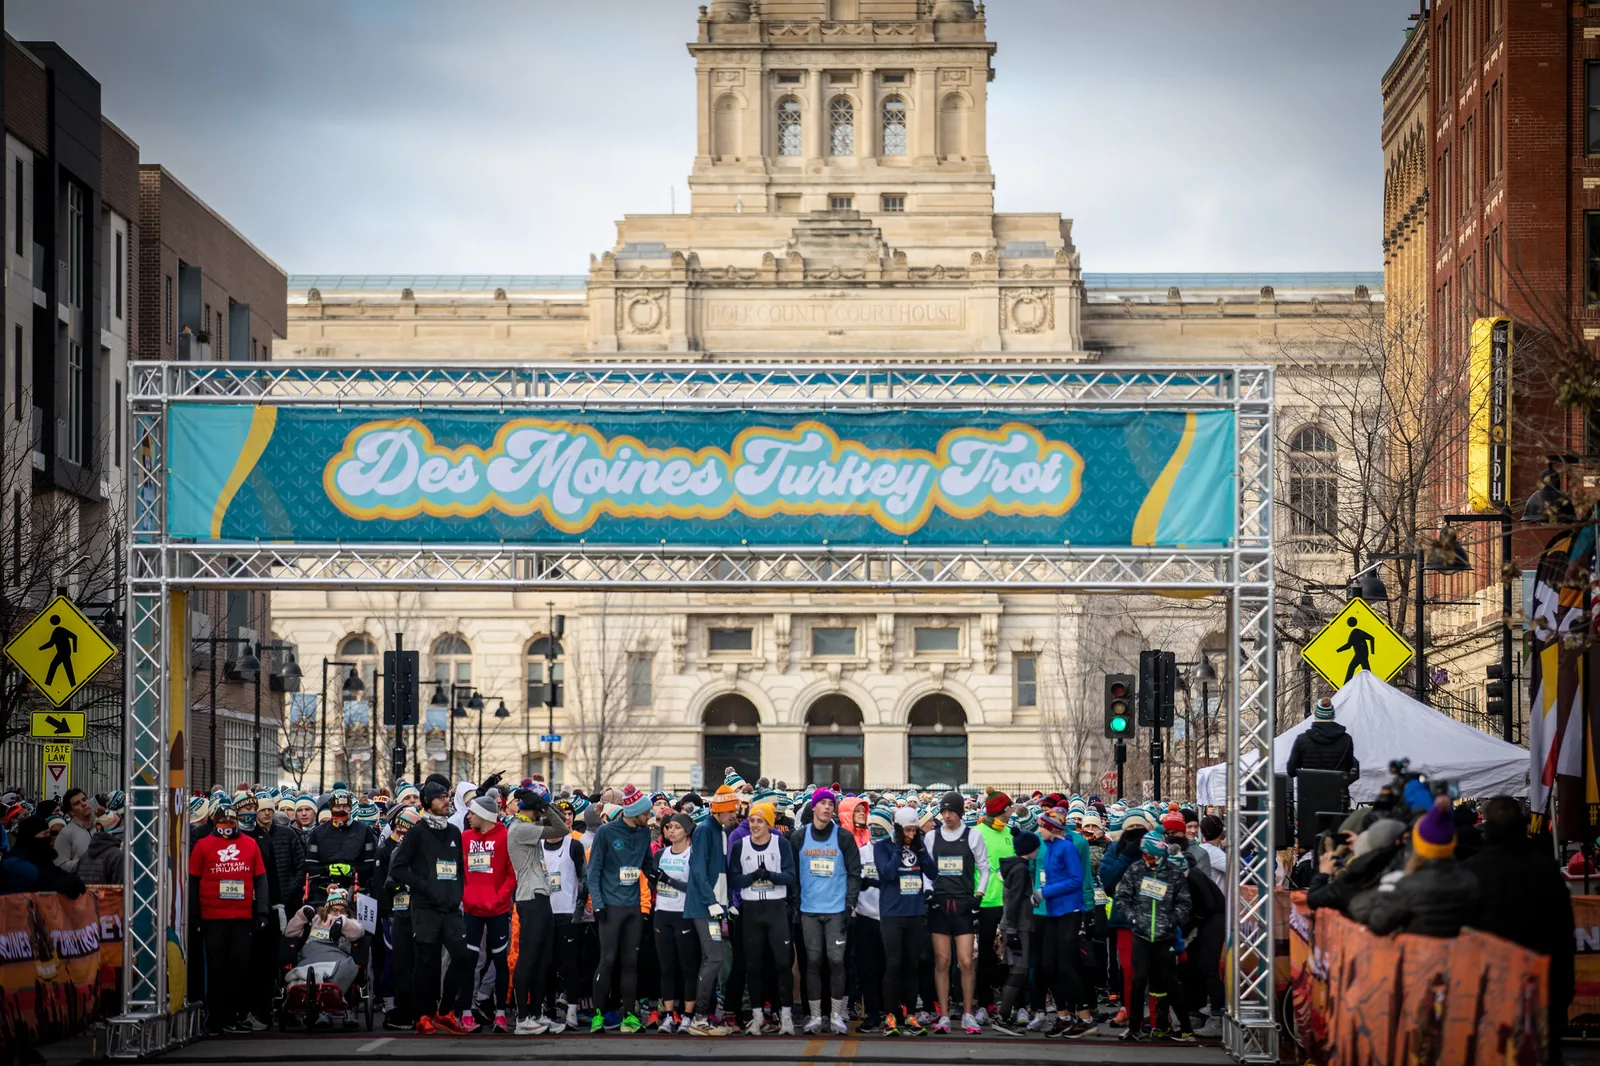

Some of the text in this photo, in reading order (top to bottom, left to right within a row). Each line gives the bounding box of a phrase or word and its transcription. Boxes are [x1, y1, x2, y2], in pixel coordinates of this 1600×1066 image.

[711, 304, 957, 323] POLK COUNTY COURT HOUSE
[336, 427, 1063, 515] Des Moines Turkey Trot
[45, 745, 70, 753] STATE
[48, 753, 66, 761] LAW
[210, 865, 250, 874] TRIUMPH
